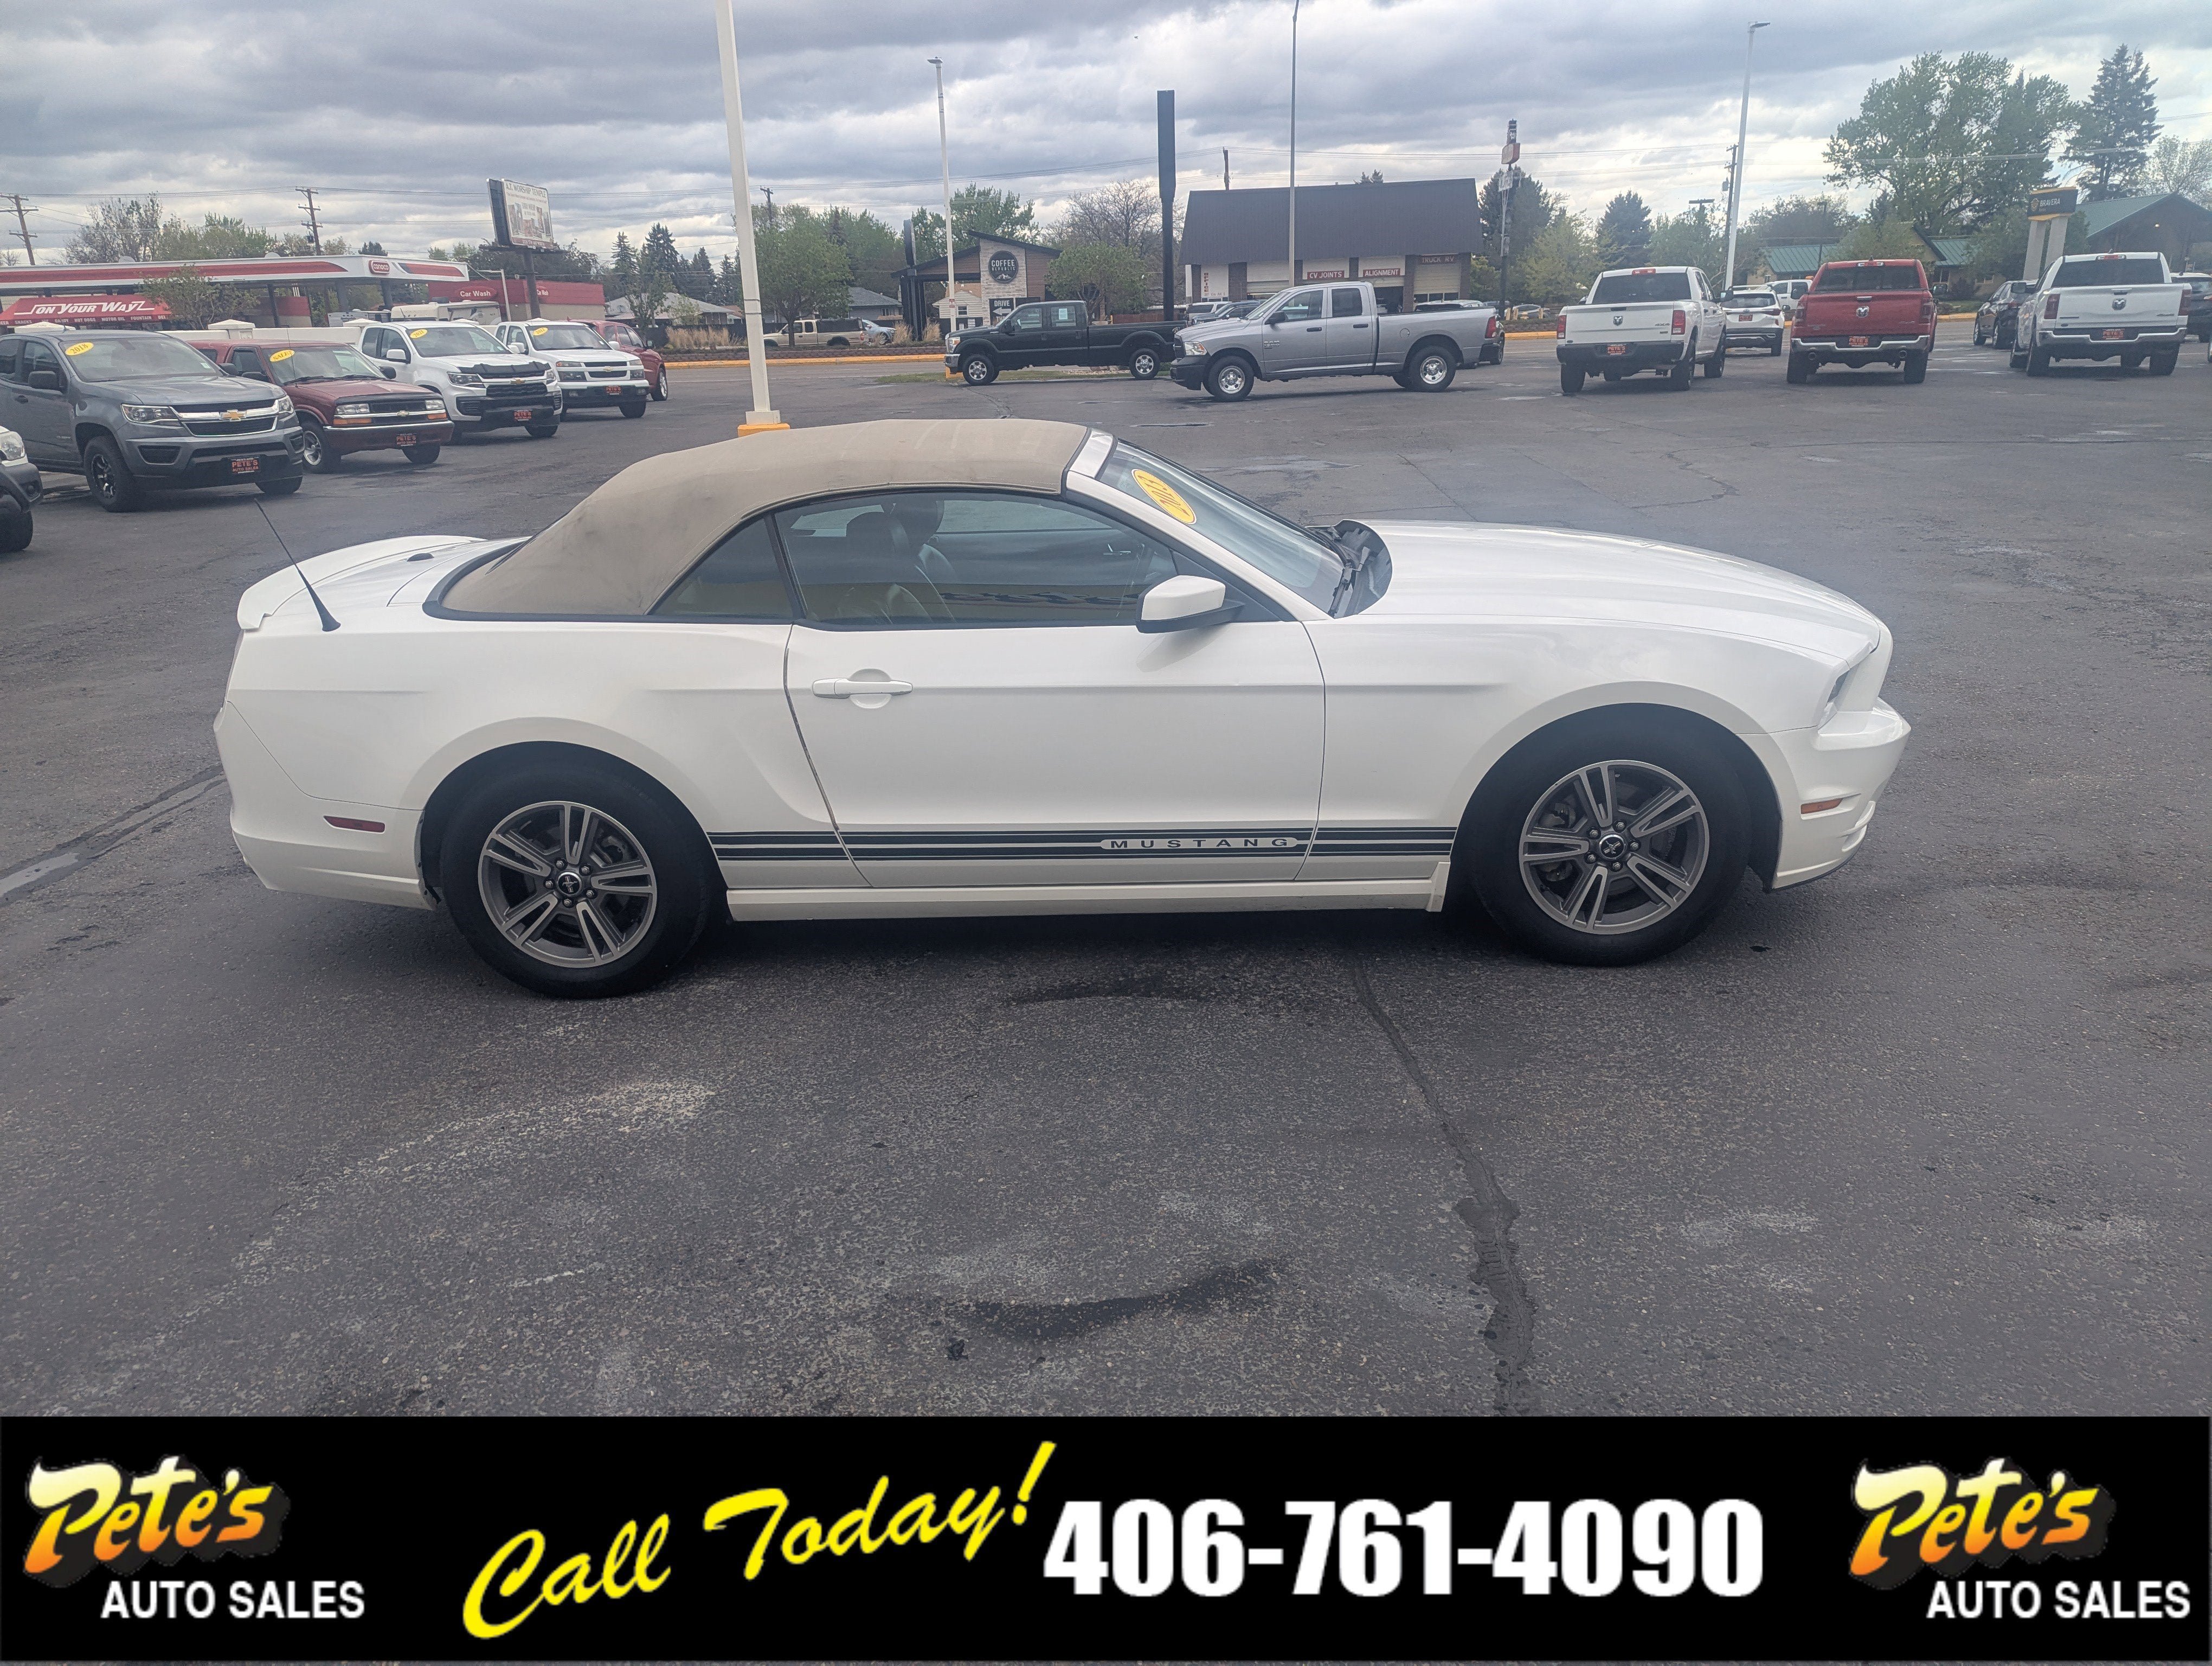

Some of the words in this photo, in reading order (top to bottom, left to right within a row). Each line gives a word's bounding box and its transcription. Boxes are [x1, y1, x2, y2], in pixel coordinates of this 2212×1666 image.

[513, 184, 531, 194] WORSHIP
[531, 188, 546, 198] TEMPLE
[2040, 198, 2060, 207] BRAVERA
[70, 343, 88, 354] 2018
[232, 459, 258, 467] PETE'S
[1137, 475, 1191, 517] 2013
[1110, 838, 1288, 848] MUSTANG
